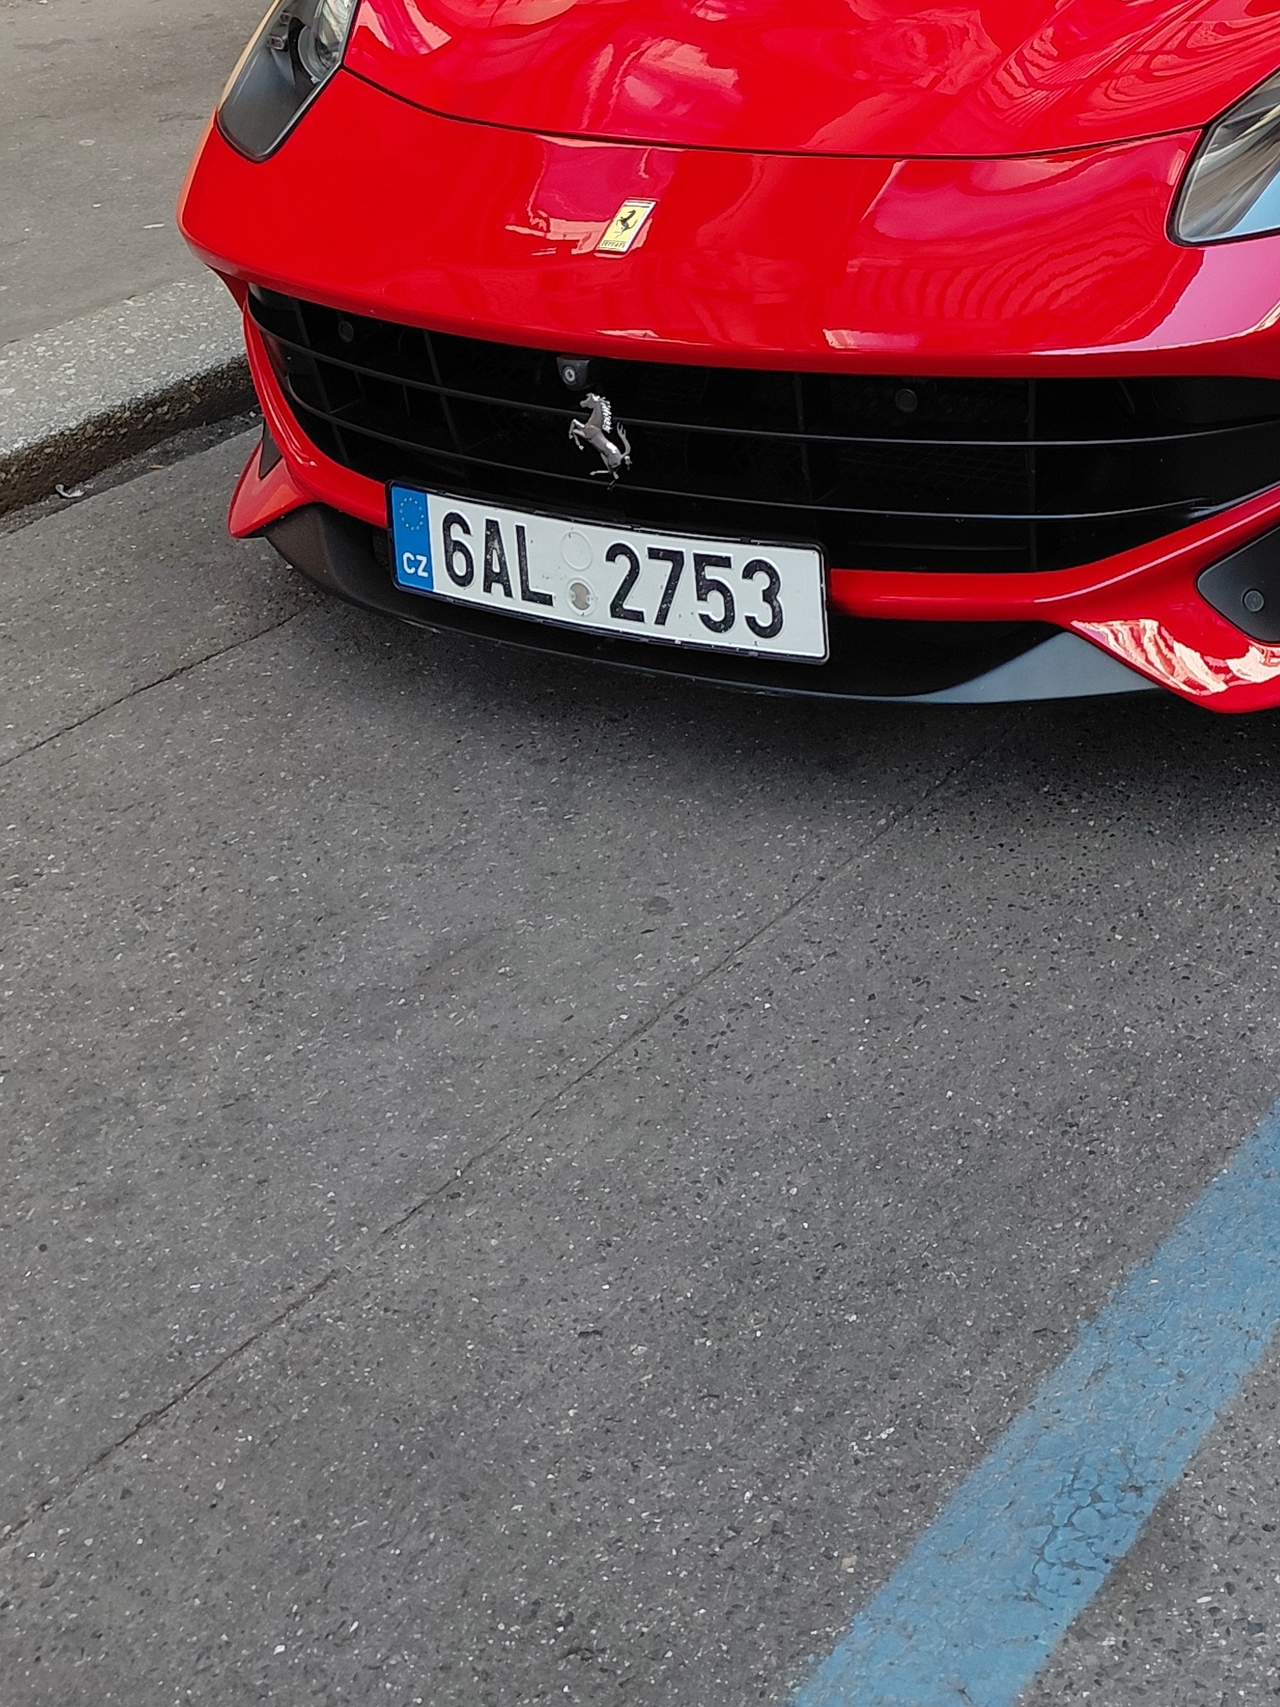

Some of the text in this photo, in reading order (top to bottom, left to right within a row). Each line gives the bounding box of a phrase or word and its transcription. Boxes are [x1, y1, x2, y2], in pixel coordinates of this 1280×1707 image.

[402, 551, 430, 579] CZ
[441, 510, 784, 640] 6AL 2753
